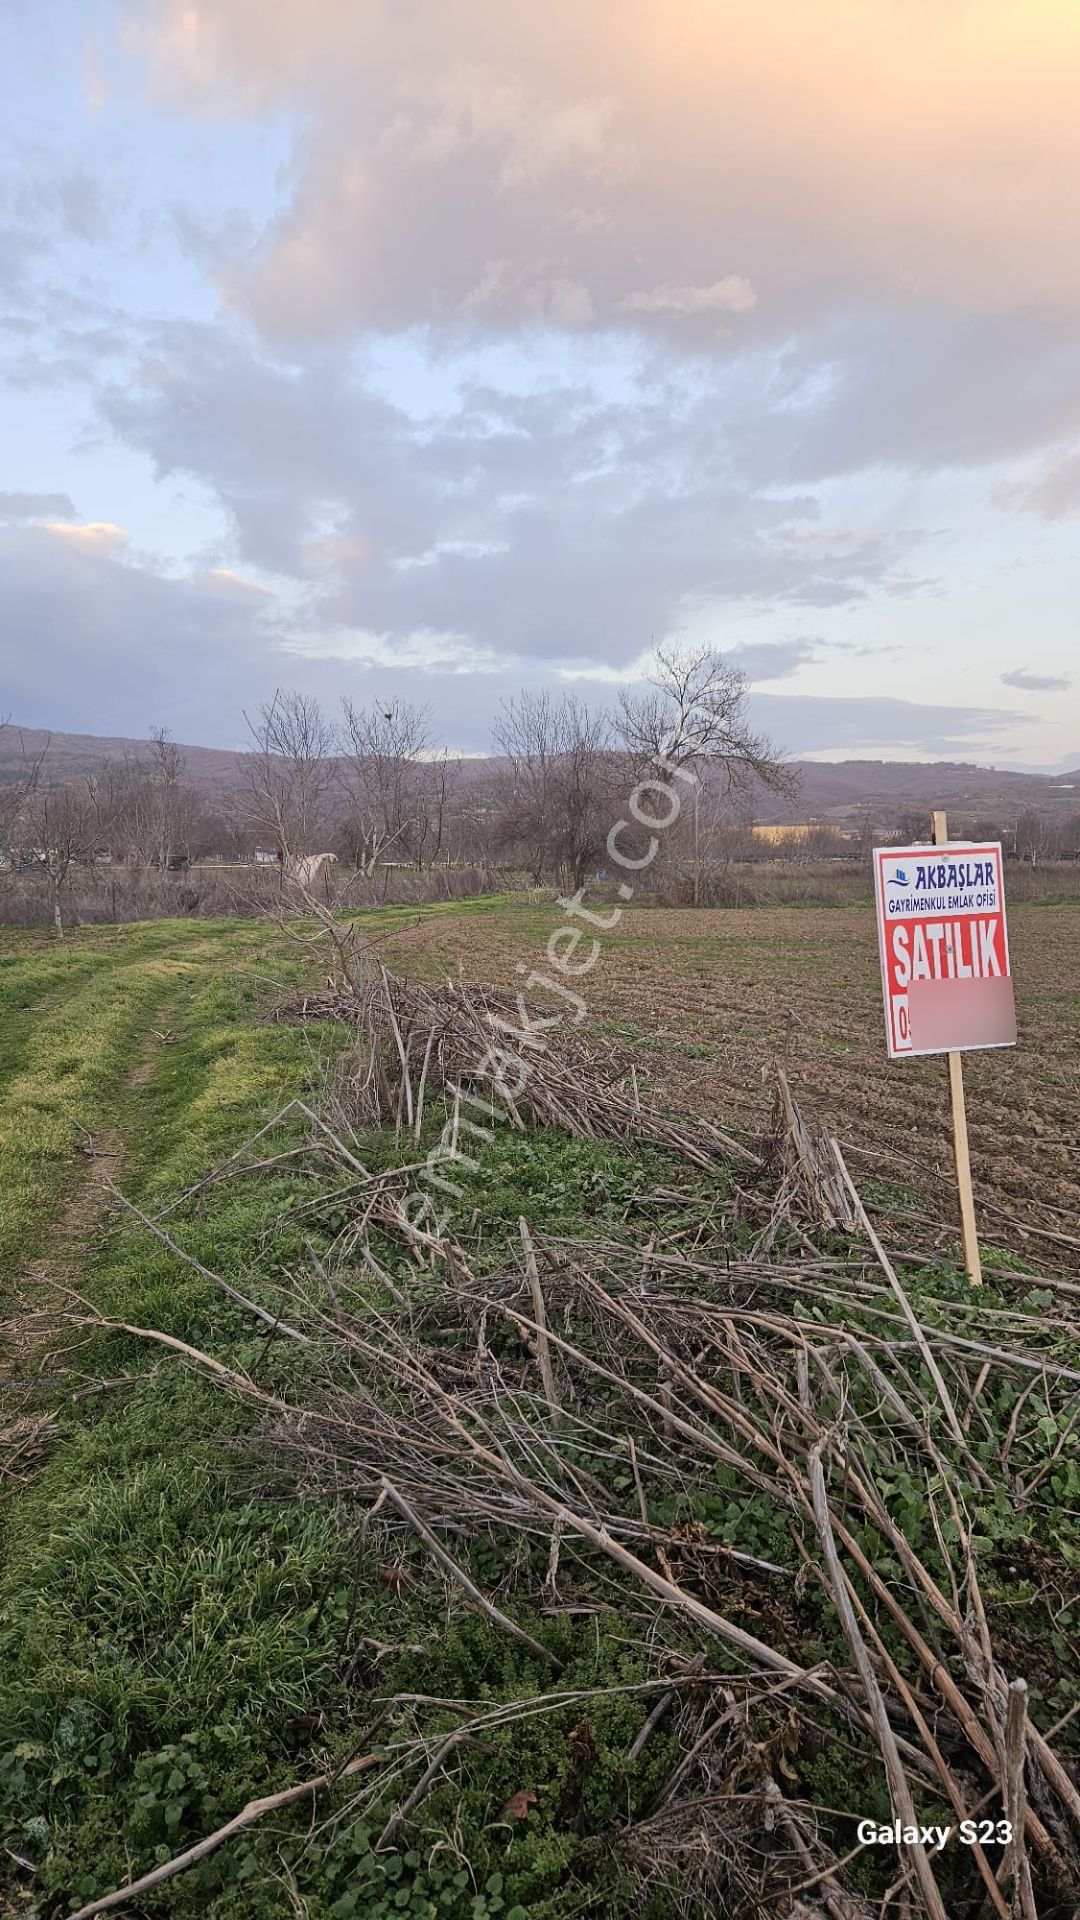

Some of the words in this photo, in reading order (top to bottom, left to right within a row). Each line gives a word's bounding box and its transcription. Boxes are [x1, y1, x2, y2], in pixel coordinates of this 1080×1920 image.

[915, 862, 995, 891] AKBAŞLAR
[888, 894, 947, 913] GAYRİMENKUL
[948, 894, 974, 909] EMLAK
[976, 889, 996, 907] OFİSİ
[892, 919, 1002, 988] SATILIK
